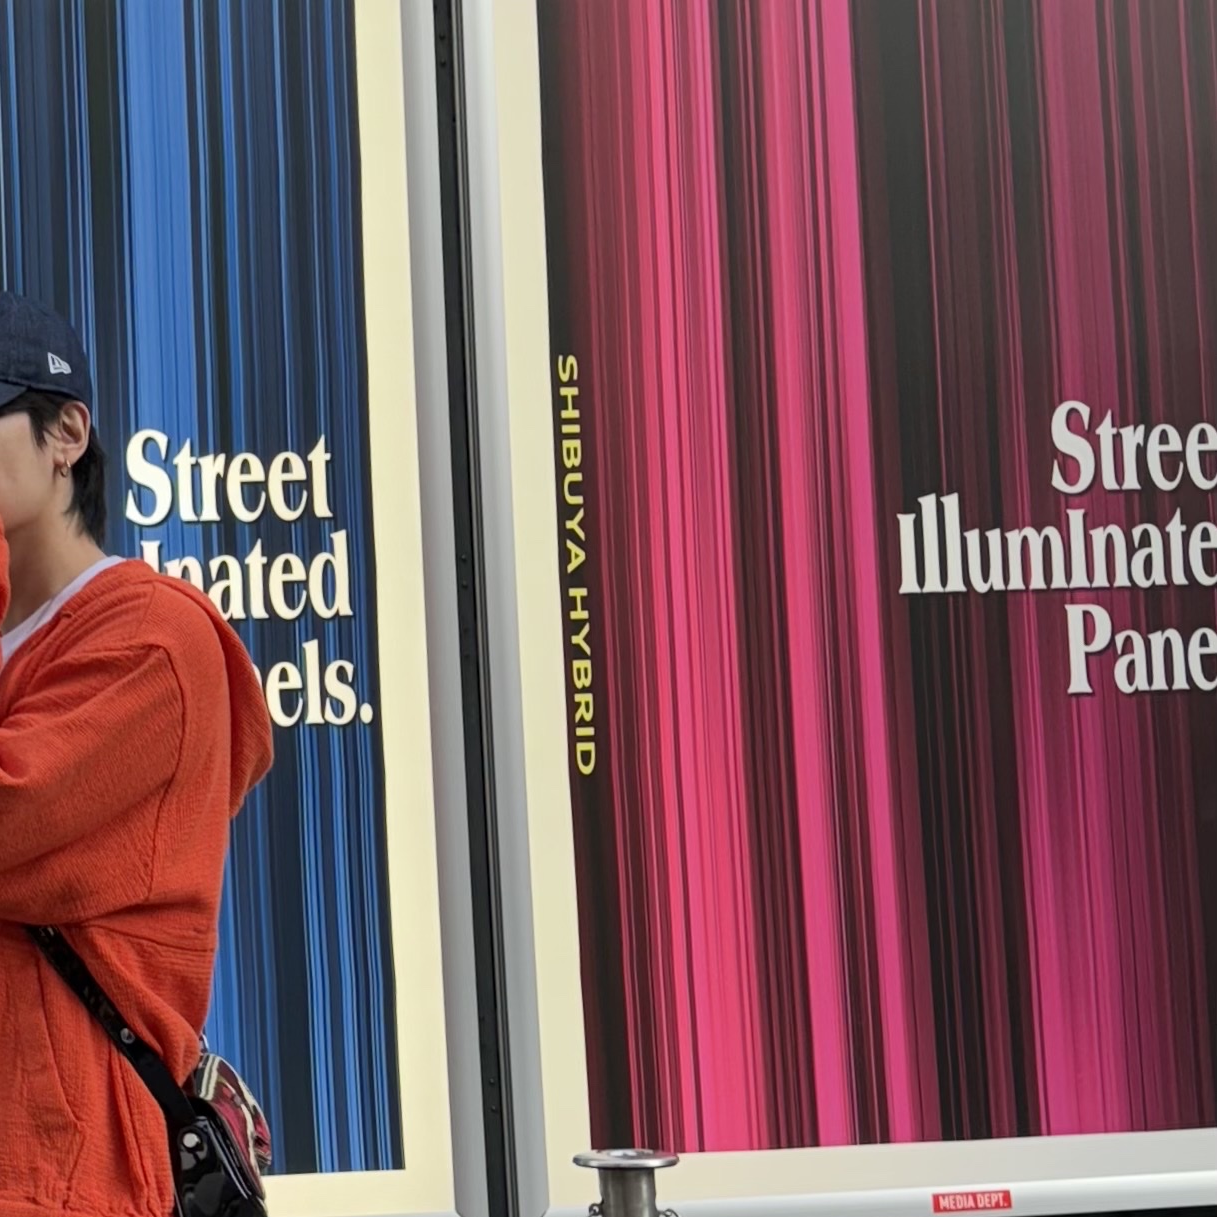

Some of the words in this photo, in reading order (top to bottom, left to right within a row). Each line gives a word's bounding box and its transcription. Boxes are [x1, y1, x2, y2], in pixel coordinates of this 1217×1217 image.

[125, 428, 333, 526] Street
[558, 354, 586, 573] SHIBUYA
[569, 587, 596, 776] HYBRID
[939, 1194, 976, 1210] MEDIA
[976, 1192, 1008, 1208] DEPT.
